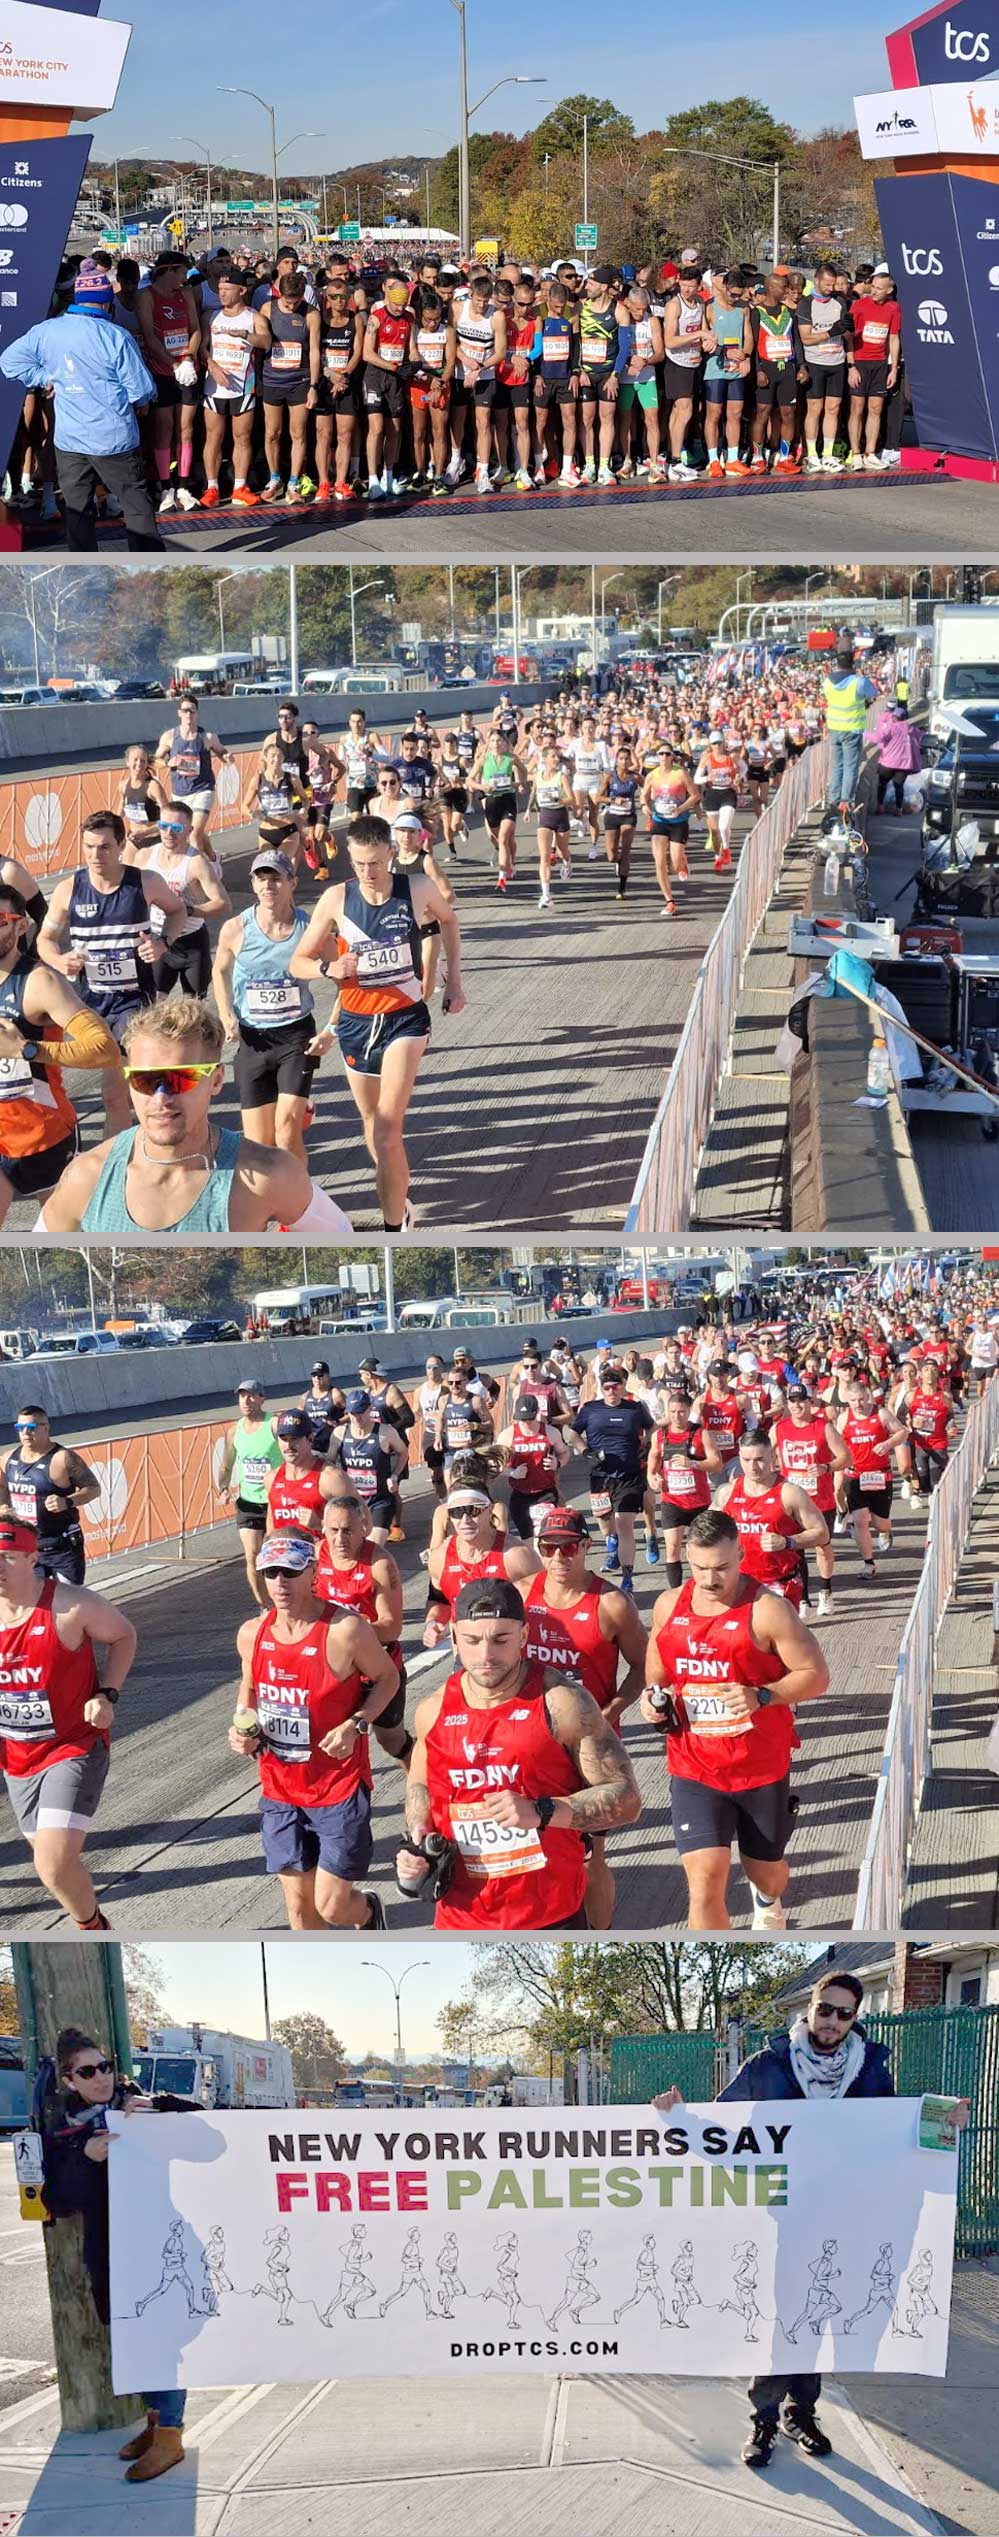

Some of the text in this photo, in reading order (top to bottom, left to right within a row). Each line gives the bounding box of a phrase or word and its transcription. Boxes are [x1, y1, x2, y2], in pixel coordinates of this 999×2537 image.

[945, 21, 990, 62] tcs
[15, 59, 44, 69] YORK
[46, 61, 69, 71] CITY
[1, 177, 43, 188] Citizens
[901, 242, 944, 276] tcs
[917, 328, 955, 344] TATA
[368, 949, 399, 968] 540
[97, 962, 122, 977] 515
[259, 990, 287, 1004] 528
[708, 1416, 733, 1425] FDNY
[850, 1435, 877, 1444] FDNY
[513, 1443, 547, 1453] FDNY
[345, 1457, 374, 1467] NYPD
[8, 1482, 37, 1495] NYPD
[275, 1507, 301, 1519] FDN
[736, 1522, 769, 1534] FDNY
[526, 1643, 581, 1666] FDNY
[676, 1657, 731, 1679] FDNY
[258, 1683, 310, 1705] FDNY
[0, 1703, 45, 1720] 6733
[444, 1714, 469, 1727] 2025
[449, 1764, 520, 1790] FDNY
[267, 2124, 793, 2162] NEW YORK RUNNERS SAY
[275, 2164, 789, 2212] FREE PALESTINE
[450, 2341, 619, 2357] DROPTCS.COM
